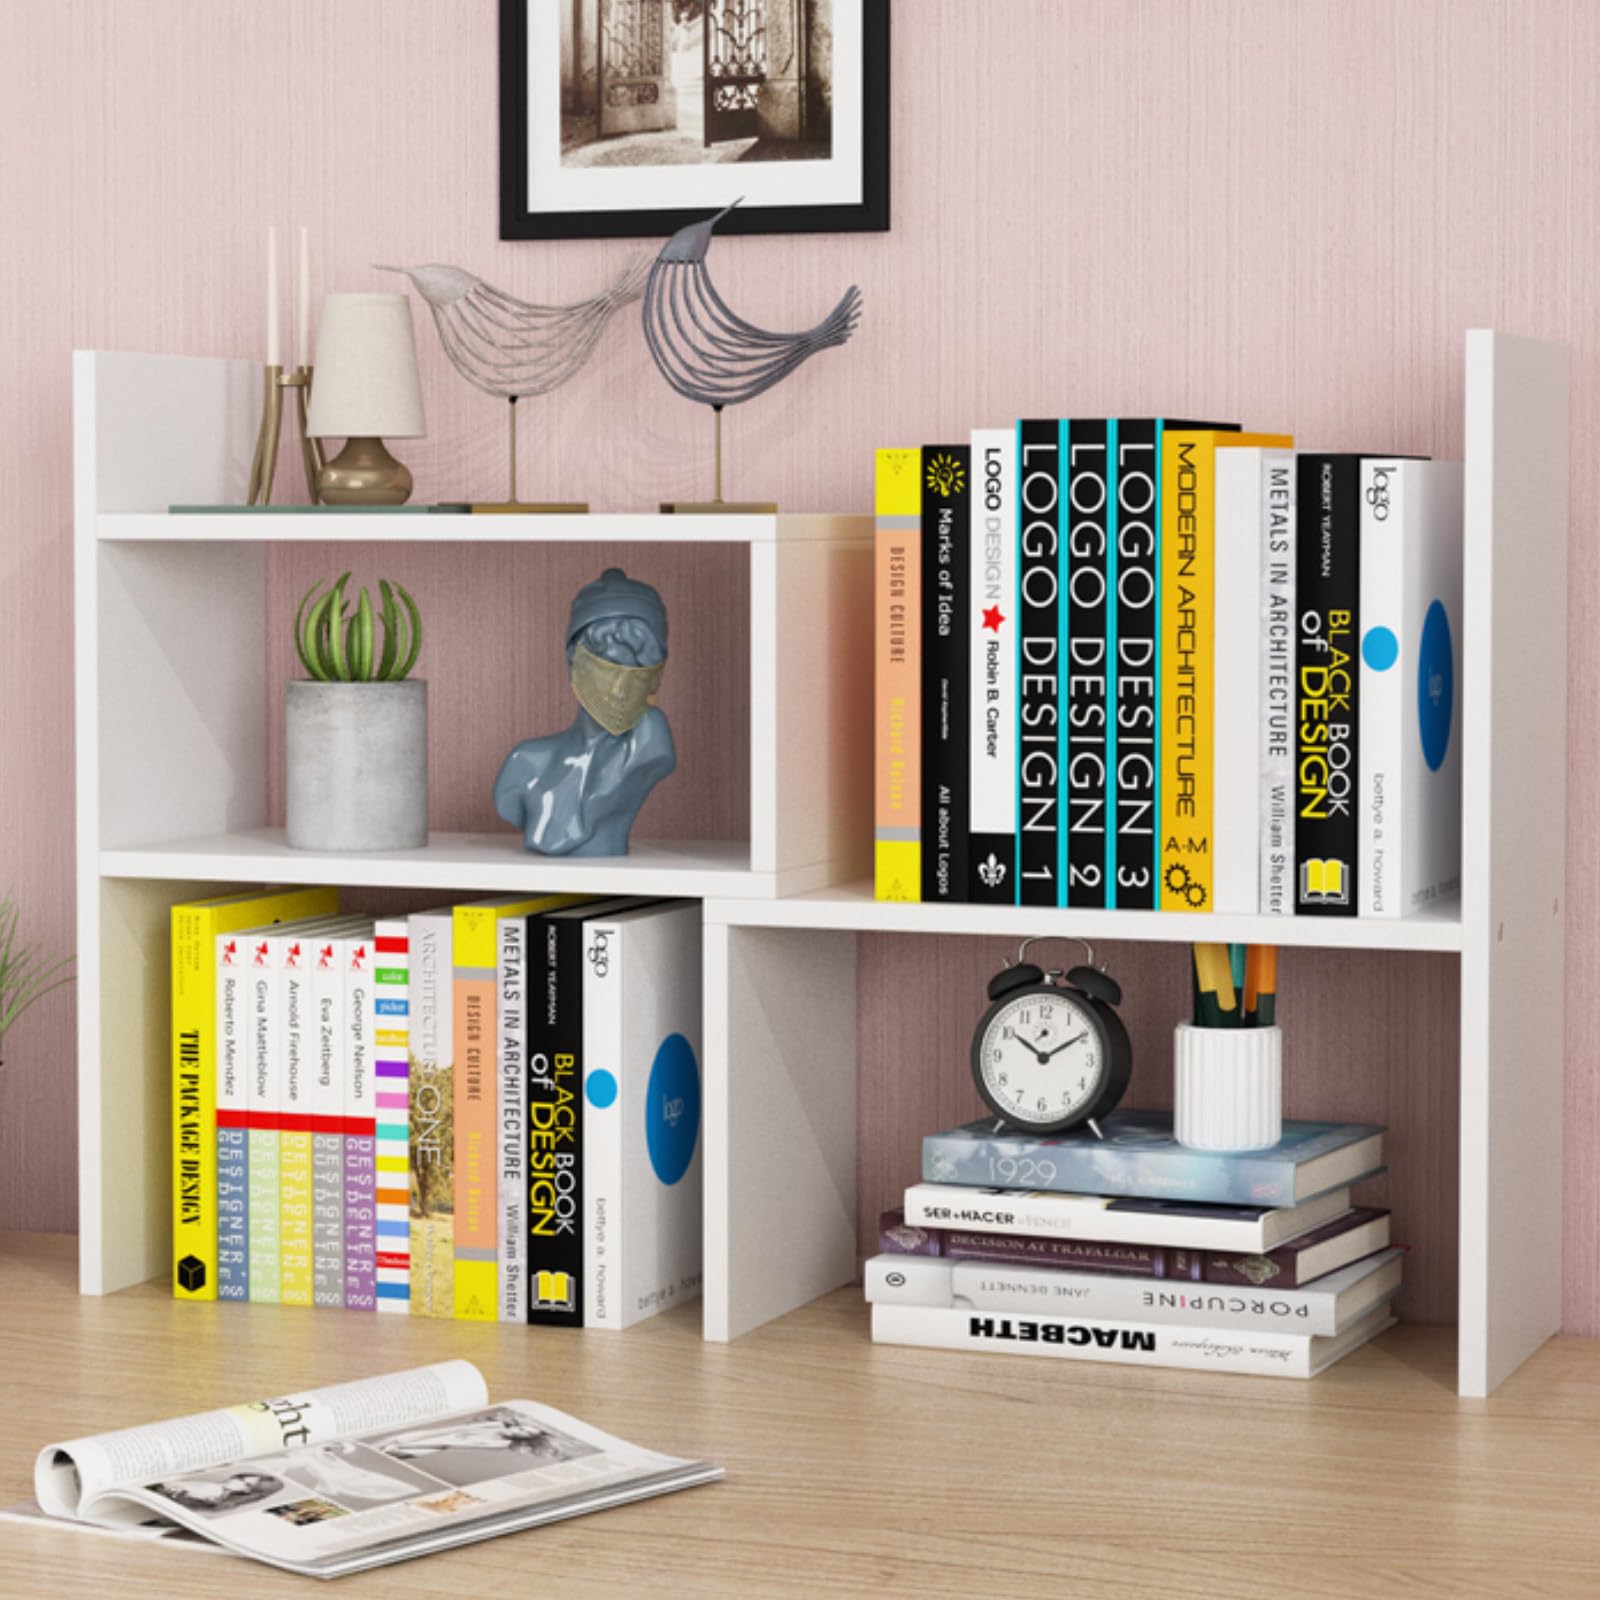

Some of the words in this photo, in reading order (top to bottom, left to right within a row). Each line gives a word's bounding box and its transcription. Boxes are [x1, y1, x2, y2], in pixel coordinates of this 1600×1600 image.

[985, 448, 1002, 511] LOGO
[1366, 467, 1397, 521] logo
[1021, 443, 1057, 608] LOGO
[1069, 443, 1106, 608] LOGO
[1117, 443, 1155, 609] LOGO
[1177, 444, 1196, 576] MODERN
[1270, 468, 1289, 552] METALS
[938, 508, 953, 563] Marks
[985, 517, 1001, 599] DESIGN
[890, 547, 905, 597] DESIGN
[938, 570, 953, 589] of
[1270, 563, 1288, 584] IN
[890, 605, 905, 664] CULTURE
[938, 595, 953, 636] Idea
[1301, 610, 1328, 652] of
[987, 641, 1000, 684] Robin
[1269, 594, 1288, 756] ARCHITECTURE
[1328, 609, 1351, 712] BLACK
[1177, 585, 1195, 817] ARCHITECTURE
[987, 707, 999, 758] Carter
[1021, 637, 1057, 832] DESIGN
[1069, 637, 1106, 833] DESIGN
[1117, 638, 1155, 834] DESIGN
[1300, 666, 1329, 818] DESIGN
[938, 785, 951, 803] All
[1328, 723, 1351, 817] BOOK
[938, 807, 951, 848] about
[1271, 785, 1285, 848] William
[936, 853, 950, 895] Logos
[1022, 865, 1052, 878] 1
[1069, 863, 1101, 888] 2
[1117, 865, 1150, 887] 3
[504, 927, 520, 1001] METALS
[587, 930, 615, 978] logo
[225, 979, 236, 1036] Roberto
[257, 981, 268, 1013] Gina
[321, 998, 332, 1022] Eva
[351, 989, 365, 1040] George
[467, 995, 481, 1041] DESIGN
[504, 1009, 520, 1029] IN
[1020, 1010, 1031, 1024] 11
[1040, 1004, 1052, 1020] 12
[180, 1030, 200, 1068] THE
[289, 1032, 300, 1101] Firehouse
[531, 1053, 555, 1091] of
[994, 1049, 1002, 1063] 9
[1086, 1053, 1094, 1068] 3
[504, 1037, 520, 1179] ARCHITECTURE
[553, 1053, 575, 1143] BLACK
[1016, 1089, 1024, 1104] 7
[1037, 1097, 1047, 1112] 6
[1061, 1091, 1071, 1105] 5
[1078, 1076, 1086, 1091] 4
[180, 1073, 200, 1155] PACKAGE
[417, 1087, 442, 1167] ONE
[180, 1160, 200, 1224] DESIGN
[530, 1102, 556, 1236] DESIGN
[553, 1152, 576, 1236] BOOK
[989, 1156, 1057, 1187] 1929
[1027, 1240, 1049, 1252] AT
[1052, 1244, 1150, 1261] TRAFALGAR
[1052, 1286, 1090, 1299] JANE
[1142, 1292, 1308, 1318] PORCUPINE
[970, 1317, 1156, 1352] MACBETH
